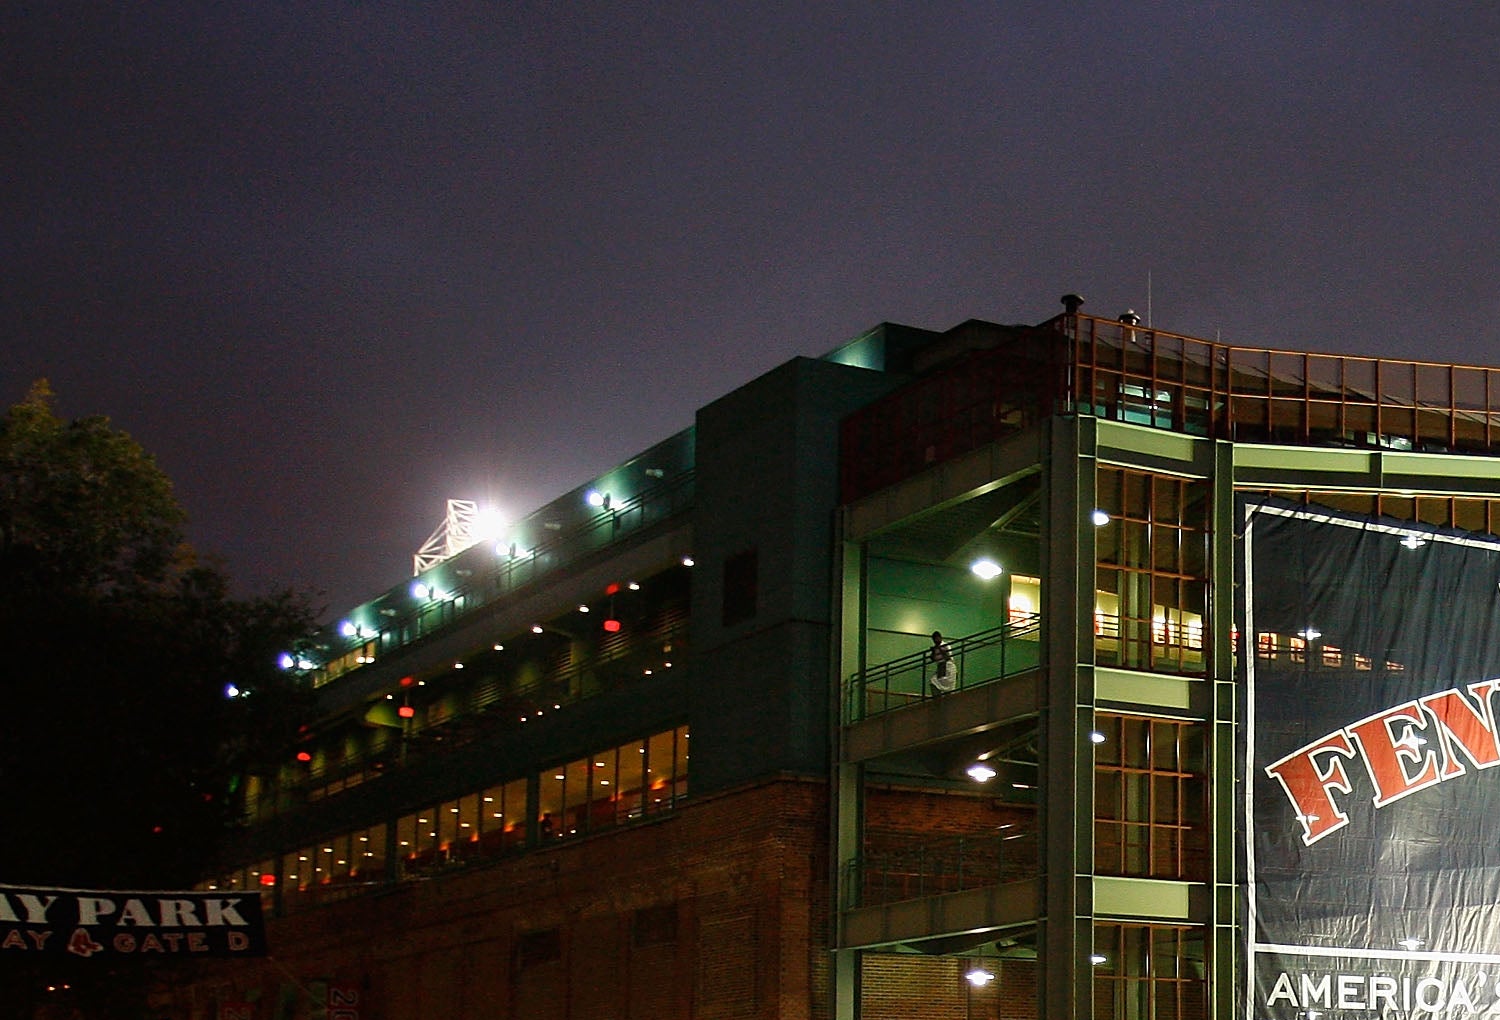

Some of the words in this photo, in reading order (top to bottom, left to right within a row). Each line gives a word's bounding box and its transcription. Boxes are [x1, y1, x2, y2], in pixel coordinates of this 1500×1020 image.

[77, 897, 249, 927] PARK
[112, 932, 209, 953] GATE
[227, 931, 250, 952] D
